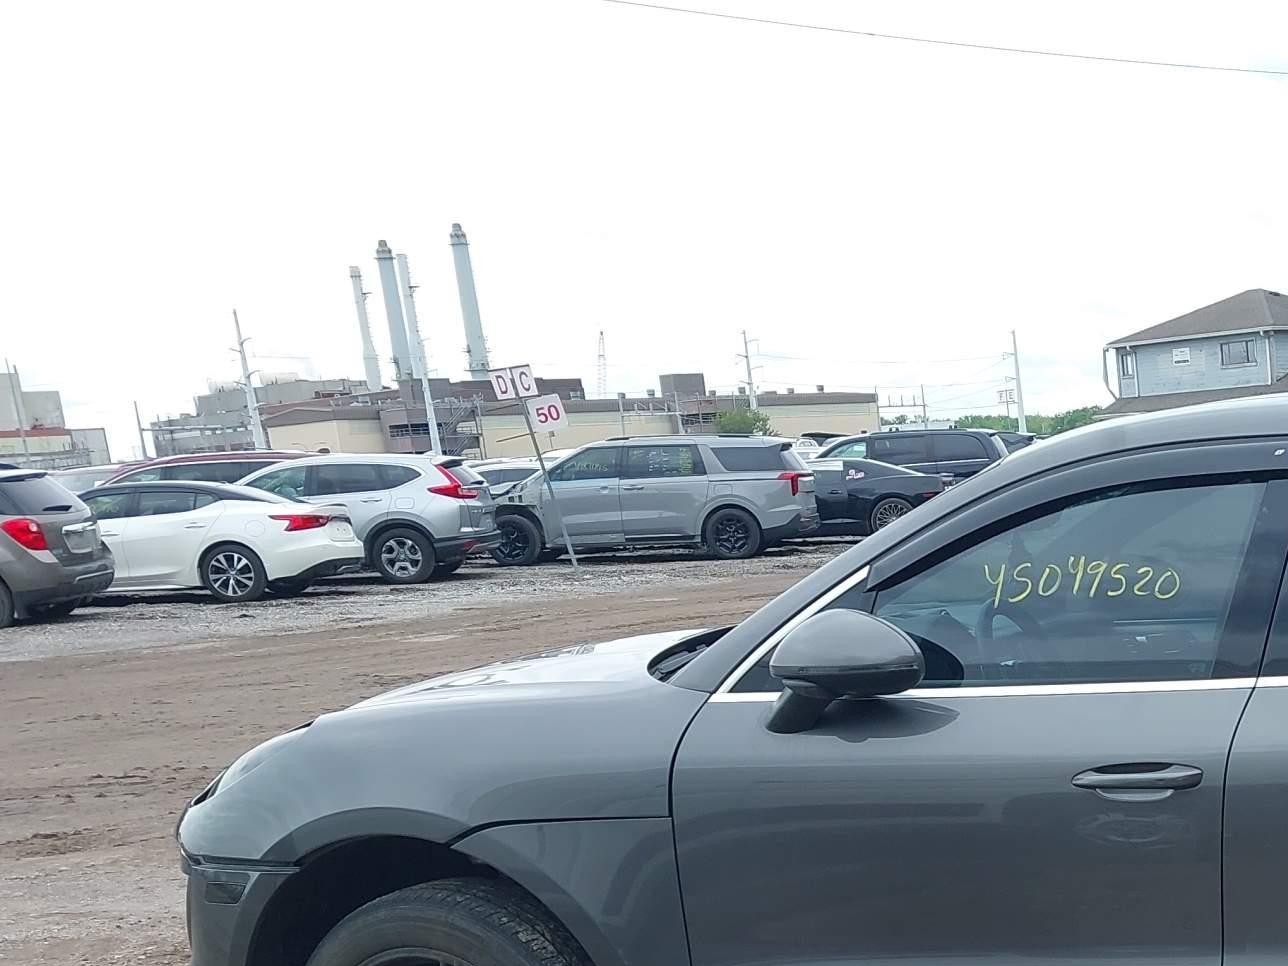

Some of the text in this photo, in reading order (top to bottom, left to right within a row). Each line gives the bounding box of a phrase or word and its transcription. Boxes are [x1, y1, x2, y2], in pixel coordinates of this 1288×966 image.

[495, 371, 531, 395] D C
[536, 404, 561, 424] 50
